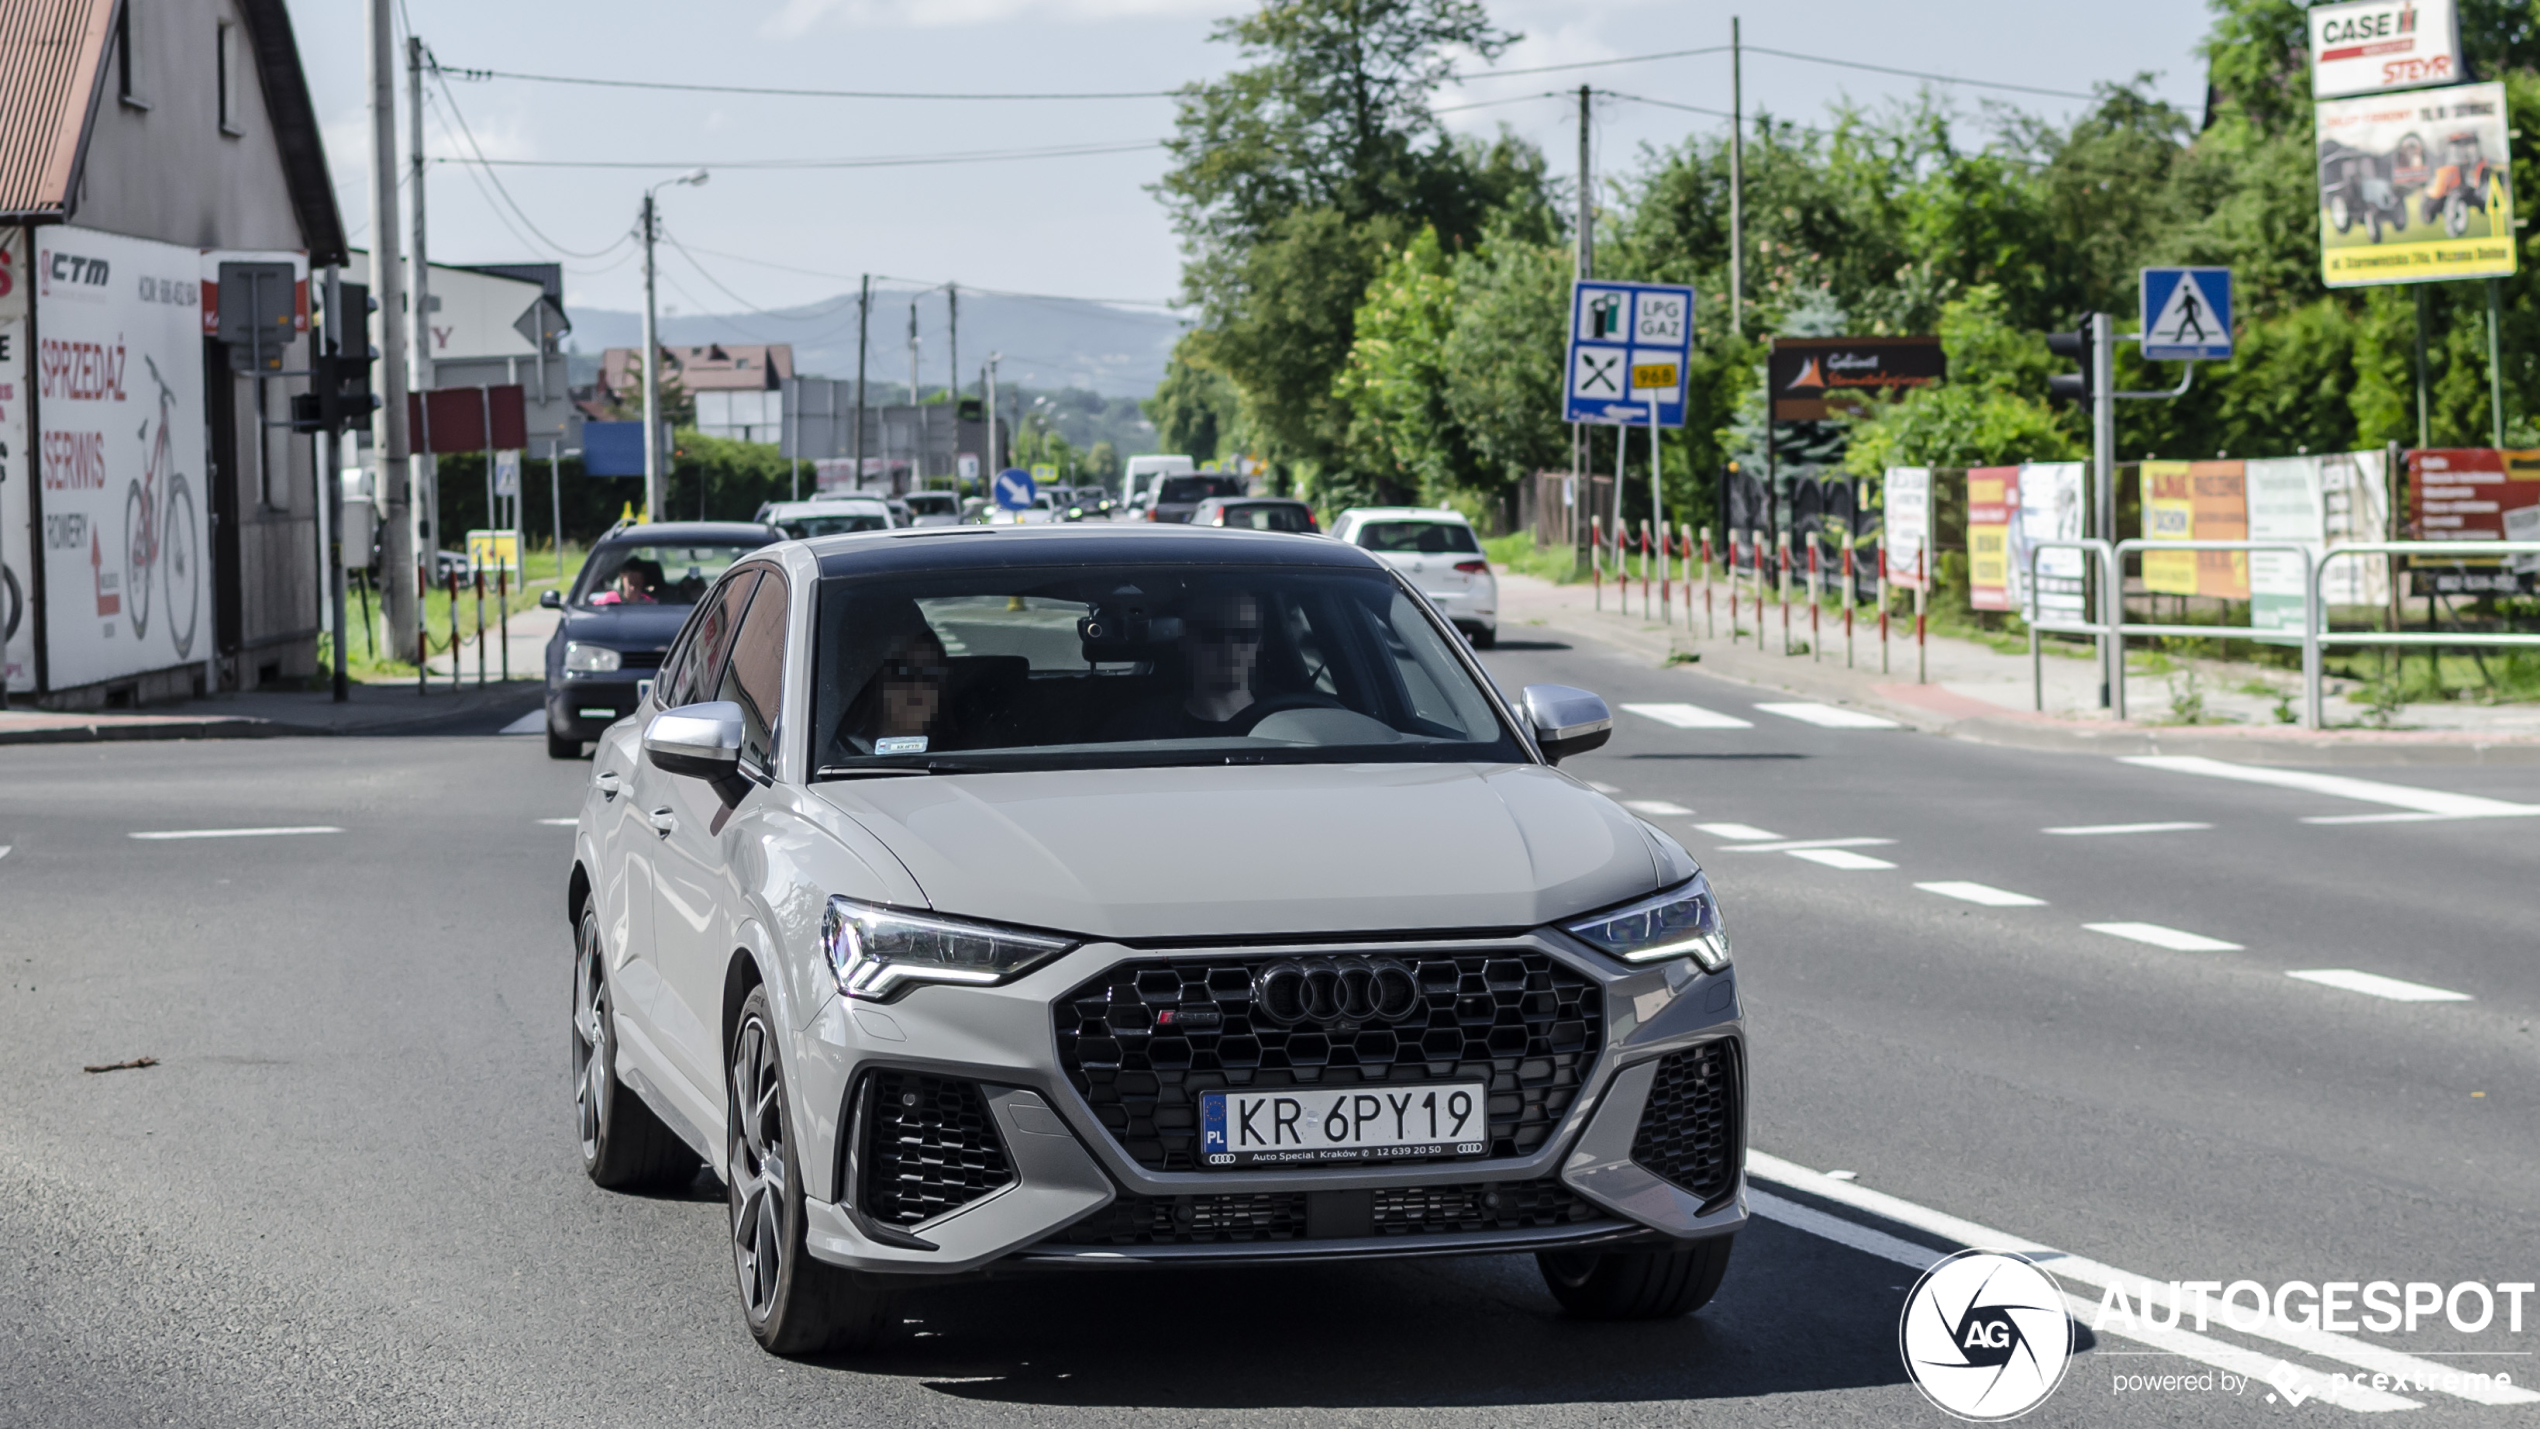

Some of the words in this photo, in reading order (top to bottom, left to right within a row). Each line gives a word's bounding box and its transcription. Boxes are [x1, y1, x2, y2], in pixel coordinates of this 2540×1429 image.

[2323, 13, 2391, 44] CASE
[2383, 55, 2451, 84] STEYR
[52, 253, 109, 286] CTM
[1643, 301, 1679, 318] LPG
[1641, 320, 1680, 337] GAZ
[1639, 368, 1672, 384] 968
[45, 431, 105, 490] SERWIS
[1240, 1098, 1302, 1146] KR
[1324, 1090, 1472, 1143] 6PY19
[1207, 1131, 1224, 1144] PL
[1252, 1153, 1277, 1161] Auto
[1279, 1151, 1315, 1161] Special
[1320, 1148, 1357, 1158] Kraków
[1377, 1148, 1389, 1156] 12
[1392, 1147, 1411, 1155] 639
[1414, 1146, 1426, 1154] 20
[1428, 1145, 1441, 1153] 50
